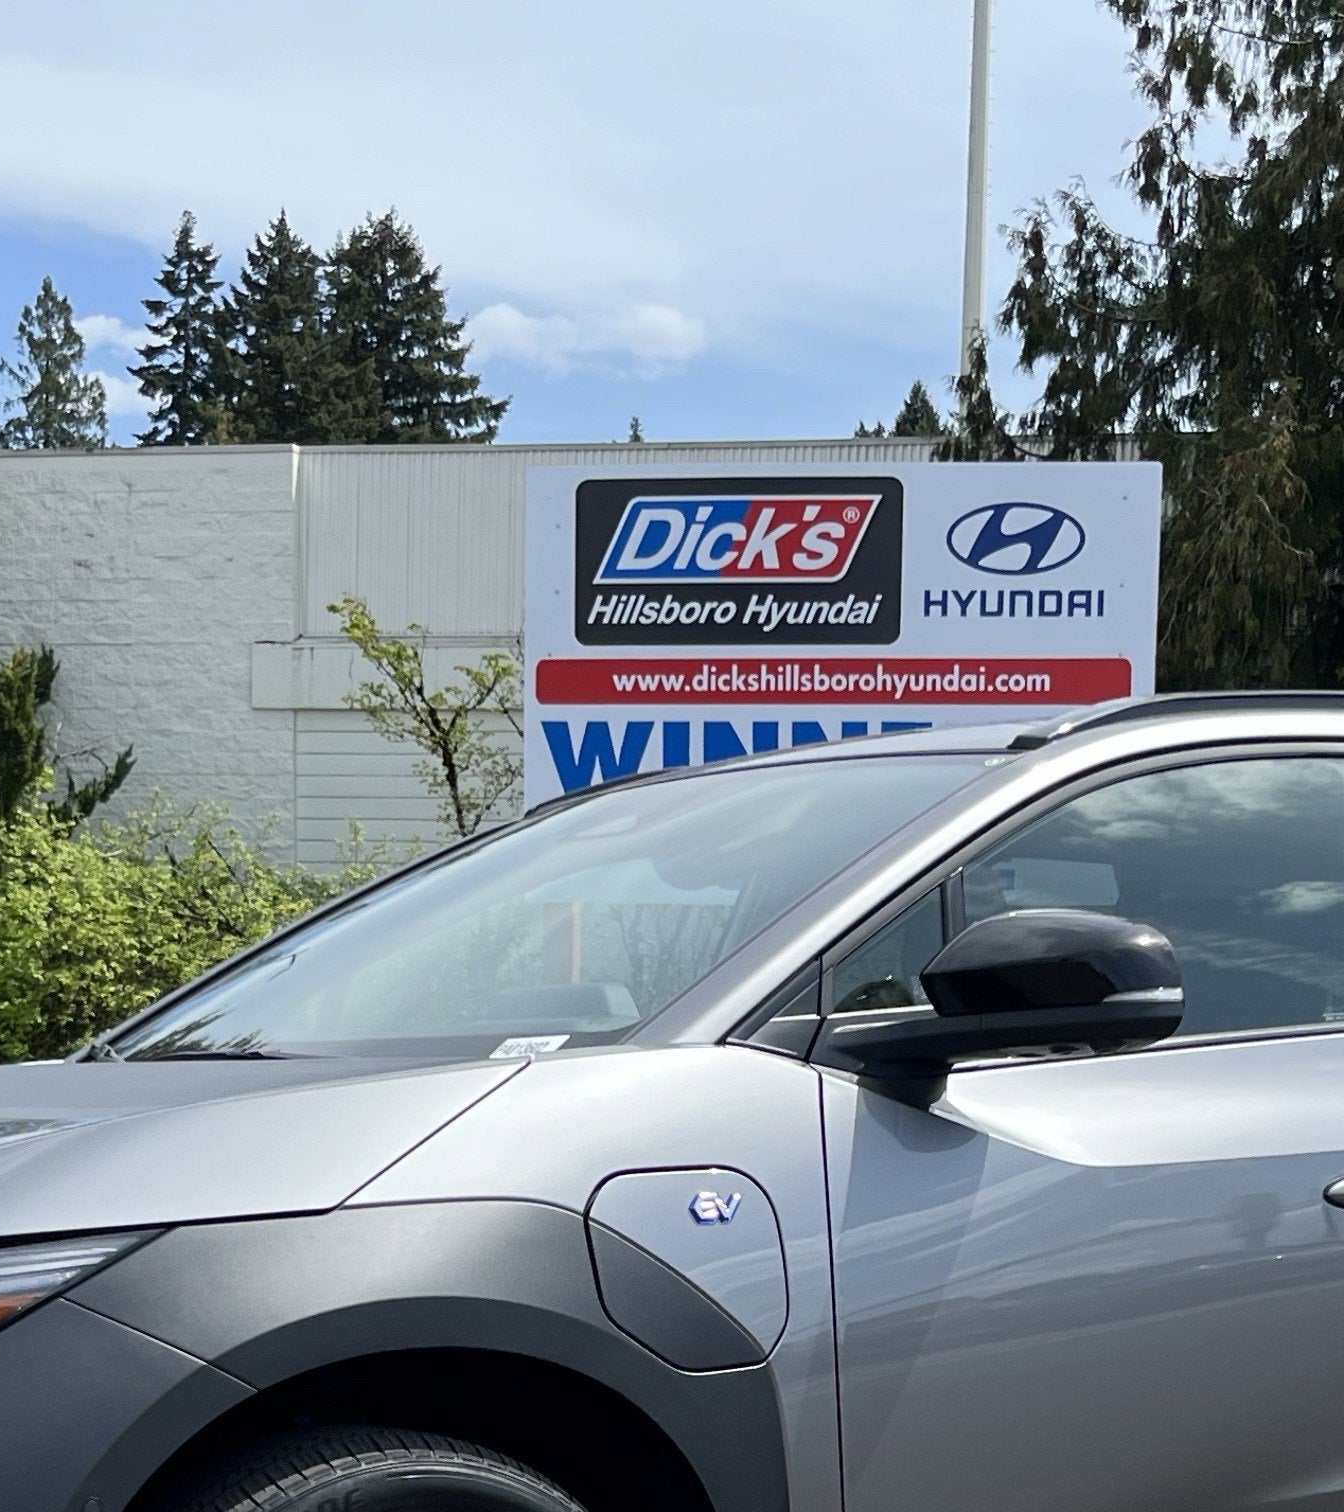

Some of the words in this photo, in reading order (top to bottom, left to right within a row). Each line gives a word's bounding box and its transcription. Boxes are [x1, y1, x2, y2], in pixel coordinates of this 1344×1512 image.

[616, 504, 843, 573] Dick's
[587, 594, 736, 625] Hillsboro
[742, 594, 883, 632] Hyundai
[923, 589, 1105, 618] HYUNDAI
[612, 664, 1051, 700] www.dickshillsborohyundai.com
[688, 1191, 742, 1226] EV
